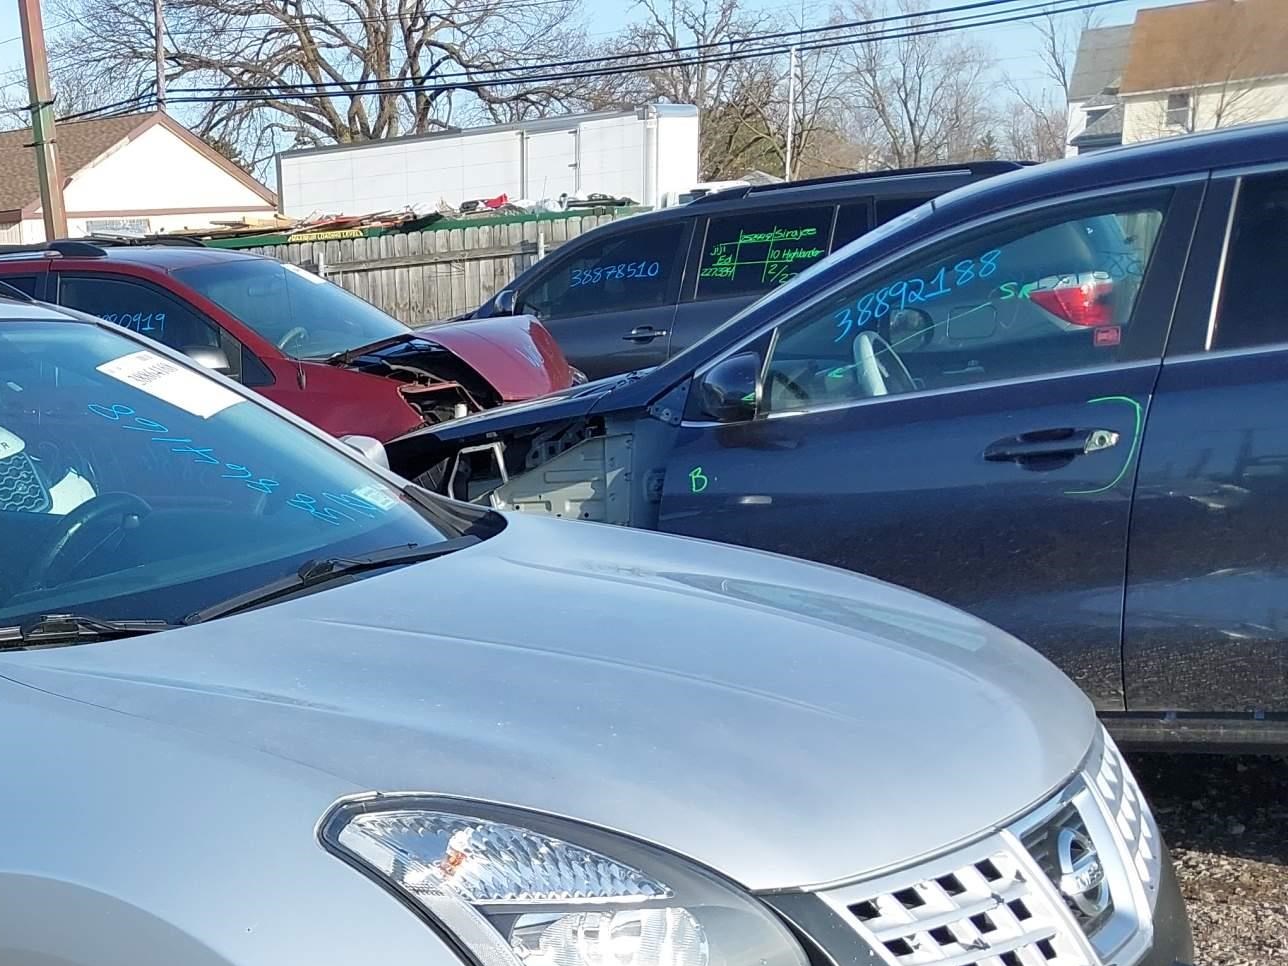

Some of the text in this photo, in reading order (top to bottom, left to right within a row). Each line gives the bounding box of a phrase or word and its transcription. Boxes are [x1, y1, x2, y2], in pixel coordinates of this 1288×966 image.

[570, 260, 659, 287] 38878510
[833, 250, 1001, 342] 38892188
[688, 466, 708, 492] B
